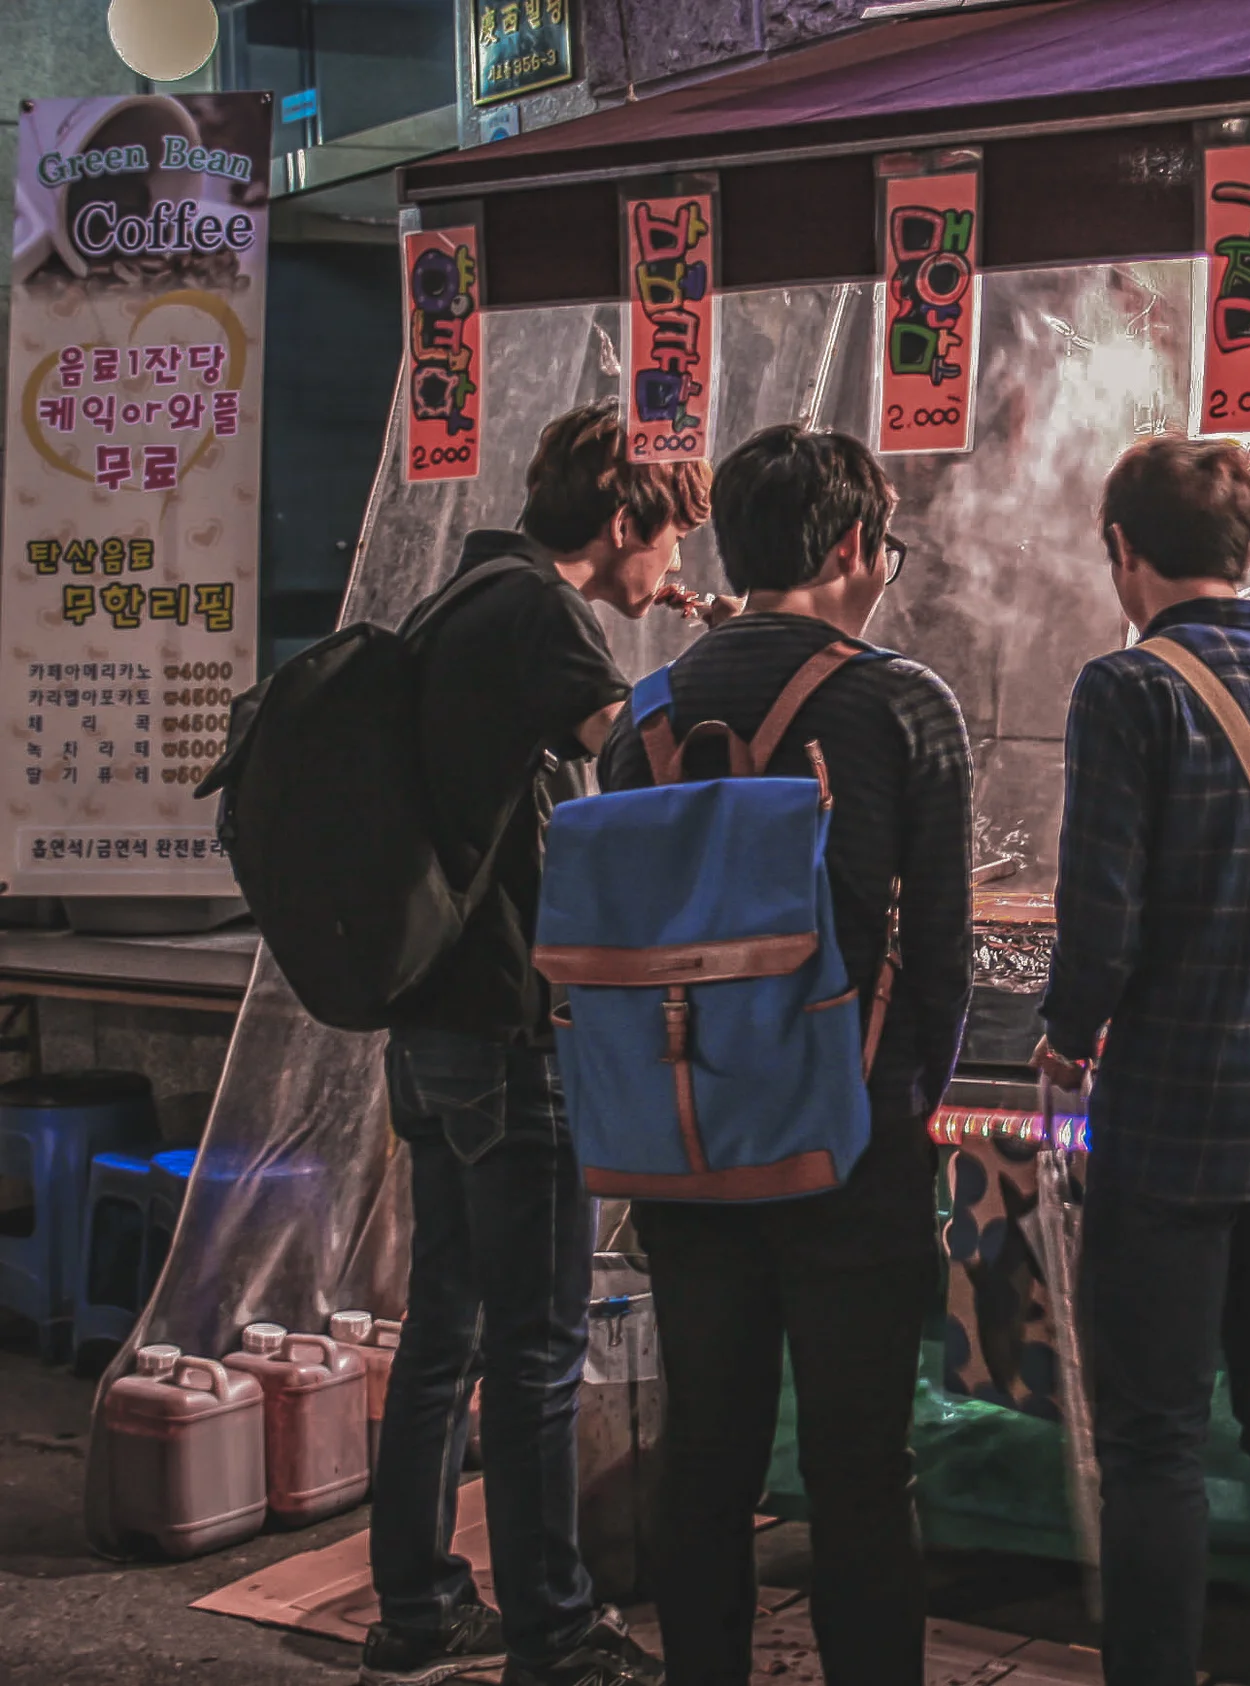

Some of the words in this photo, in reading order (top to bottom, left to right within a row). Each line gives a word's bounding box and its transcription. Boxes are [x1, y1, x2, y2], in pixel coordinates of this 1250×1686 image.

[37, 145, 149, 186] Green
[160, 135, 252, 181] Bean
[75, 200, 254, 254] Coffee
[95, 445, 179, 491] 무료
[27, 539, 154, 574] 탄산음료
[62, 582, 235, 632] 무한리필
[29, 663, 152, 682] 카페아메리카노
